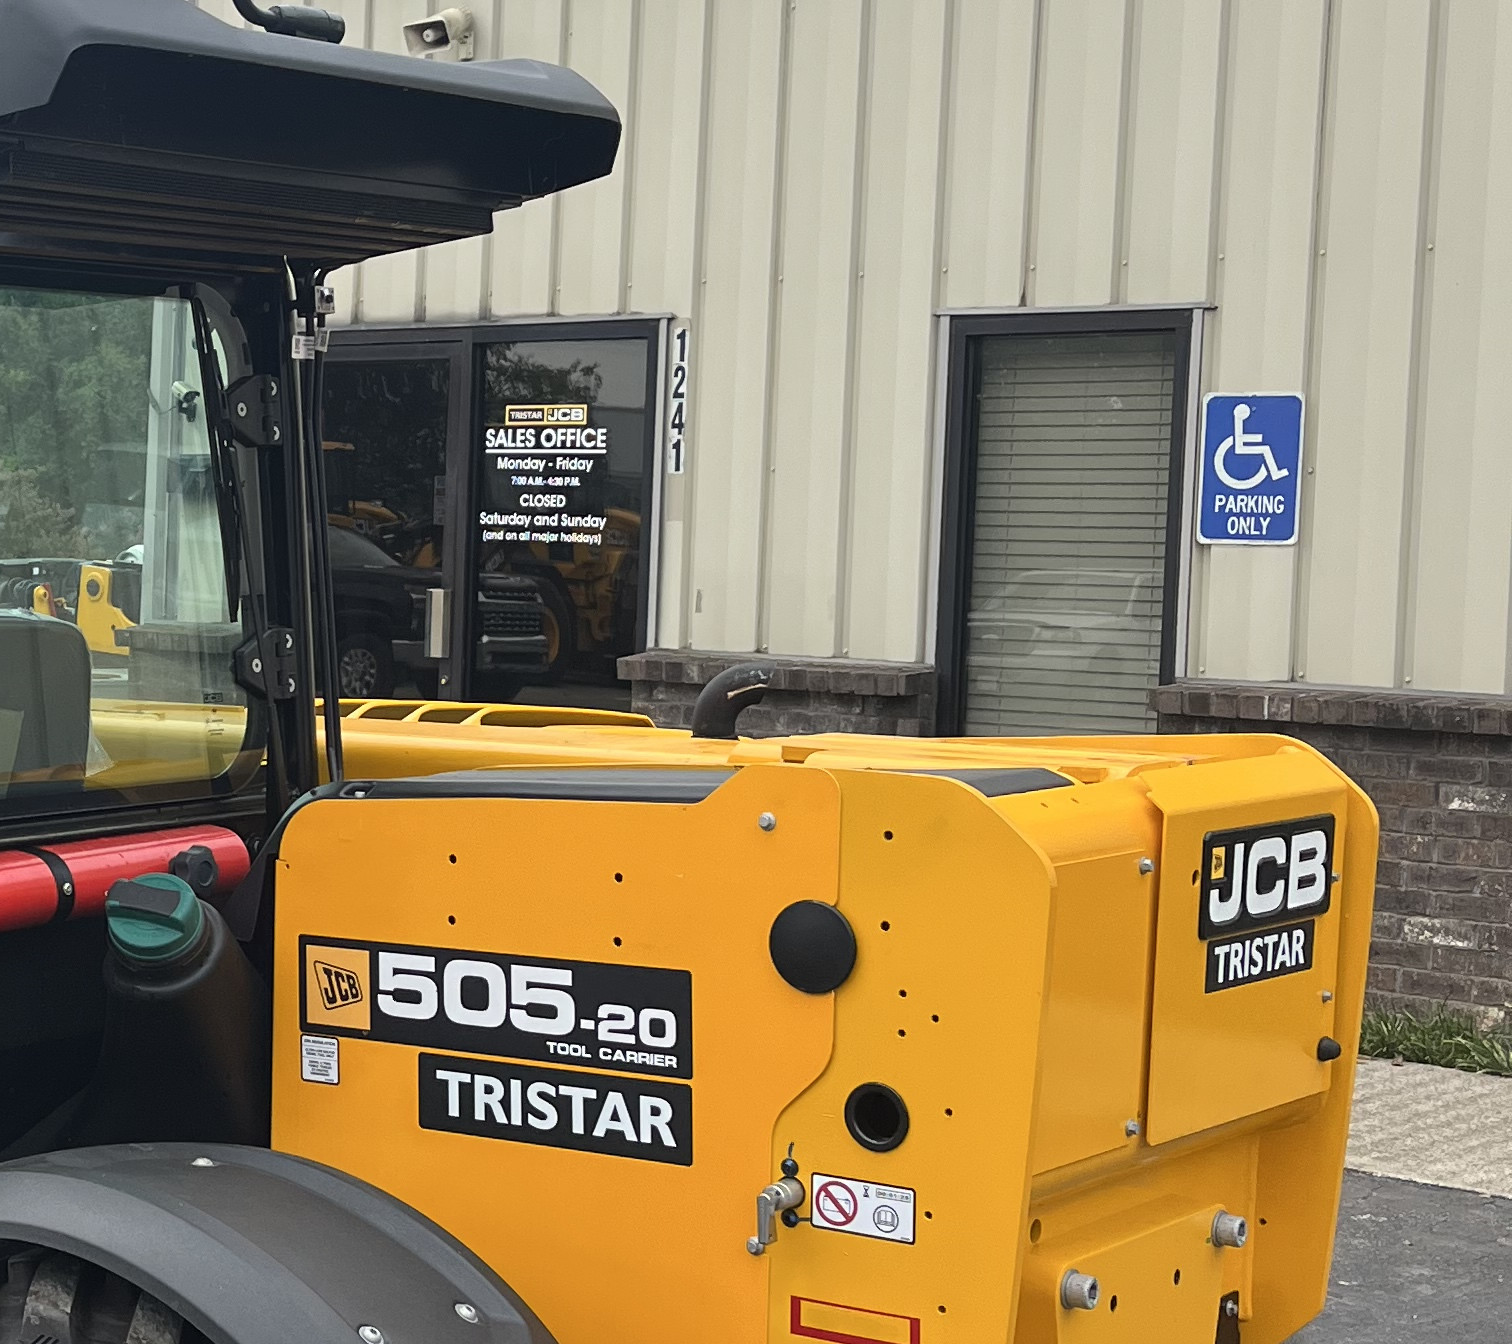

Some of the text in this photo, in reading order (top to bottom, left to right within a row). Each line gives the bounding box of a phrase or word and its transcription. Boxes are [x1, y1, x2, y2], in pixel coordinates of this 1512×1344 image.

[670, 328, 687, 472] 1241
[509, 408, 584, 421] TRISTAR JCB
[485, 428, 607, 448] SALES OFFICE
[496, 456, 546, 472] Monday
[556, 456, 594, 472] Friday
[519, 494, 566, 507] CLOSED
[1214, 494, 1285, 514] PARKING
[480, 511, 607, 530] Saturday and Sunday
[1227, 516, 1271, 535] ONLY
[505, 532, 517, 540] on
[518, 531, 531, 540] all
[531, 531, 559, 543] major
[560, 532, 602, 545] holidays)
[1209, 830, 1327, 923] JCB
[1214, 928, 1305, 984] TRISTAR
[322, 966, 359, 1005] JCB
[546, 1040, 678, 1069] TOOL CARRIER
[435, 1069, 678, 1148] TRISTAR
